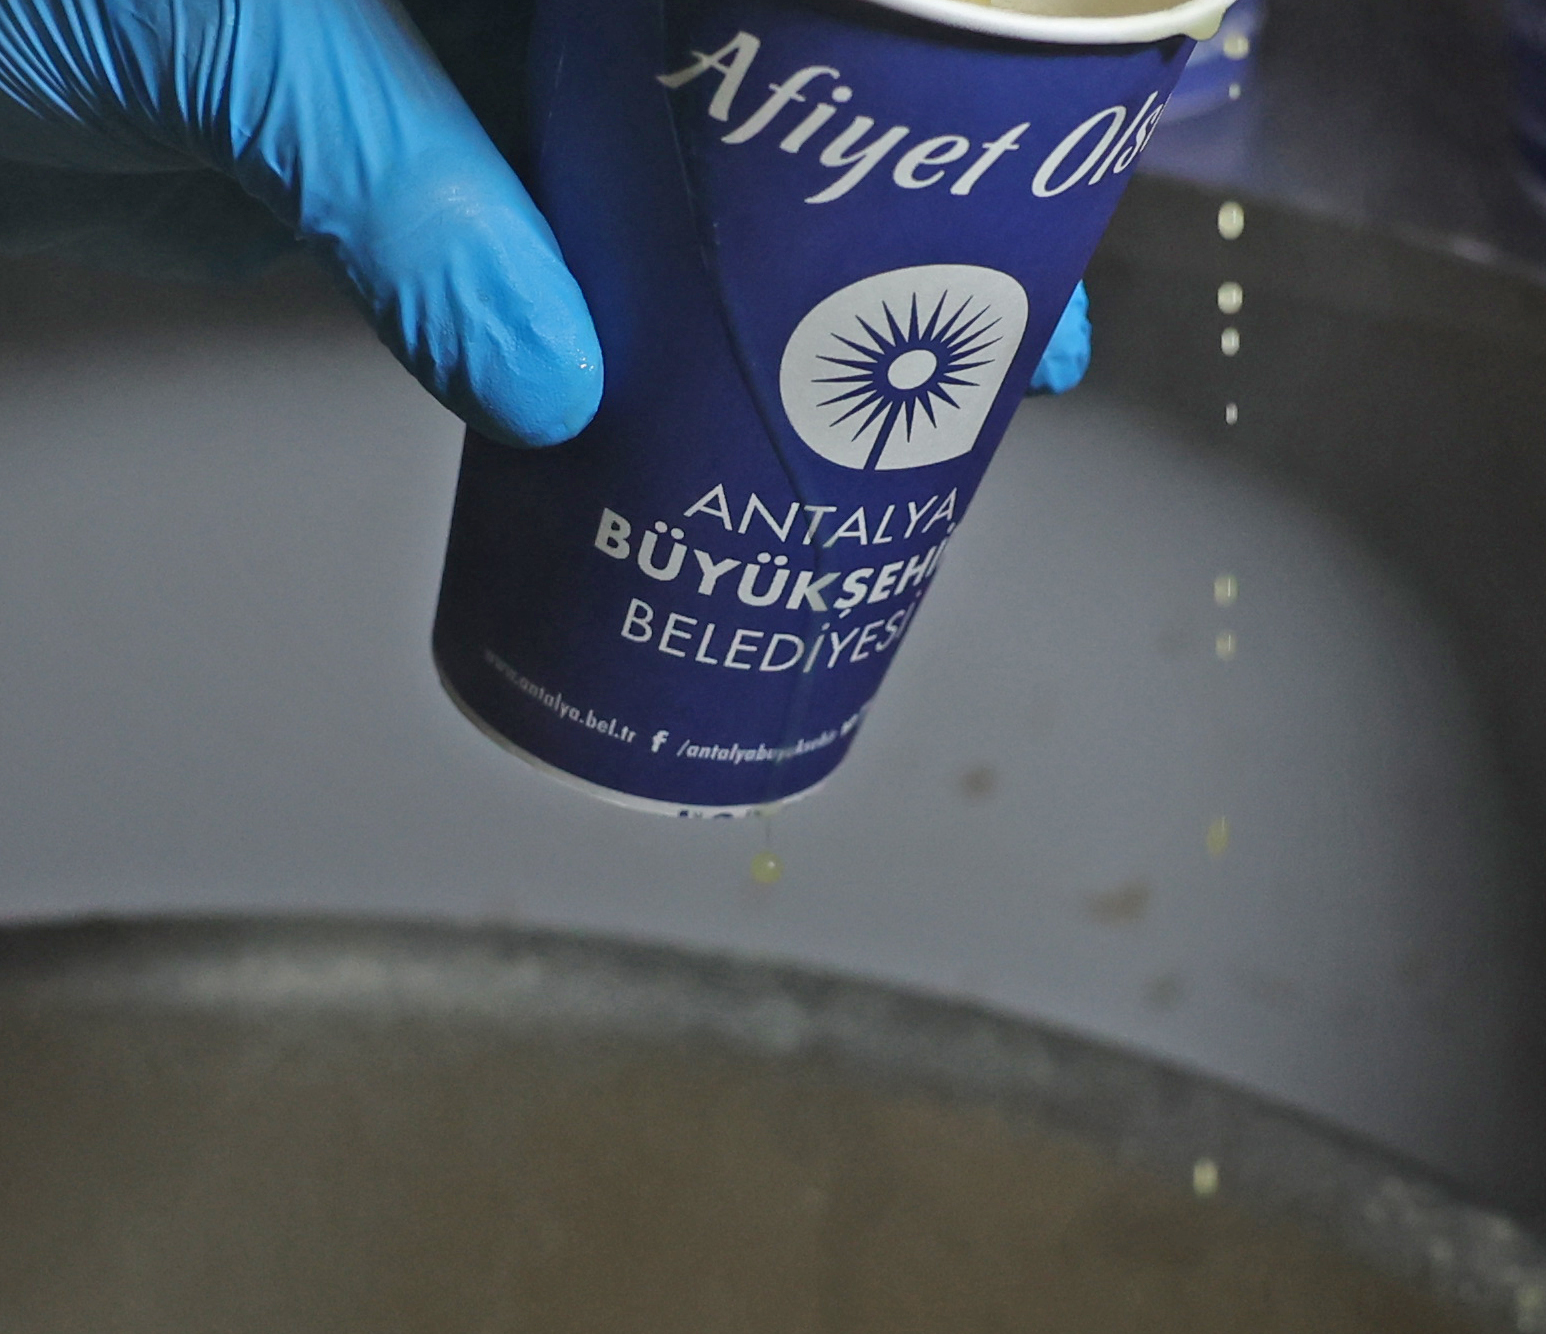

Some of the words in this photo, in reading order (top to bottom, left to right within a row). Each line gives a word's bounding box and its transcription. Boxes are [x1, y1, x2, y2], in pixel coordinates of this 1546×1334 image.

[656, 32, 1031, 205] Afiyet
[683, 483, 958, 549] ANTALYA
[620, 589, 923, 674] BELEDİYESİ
